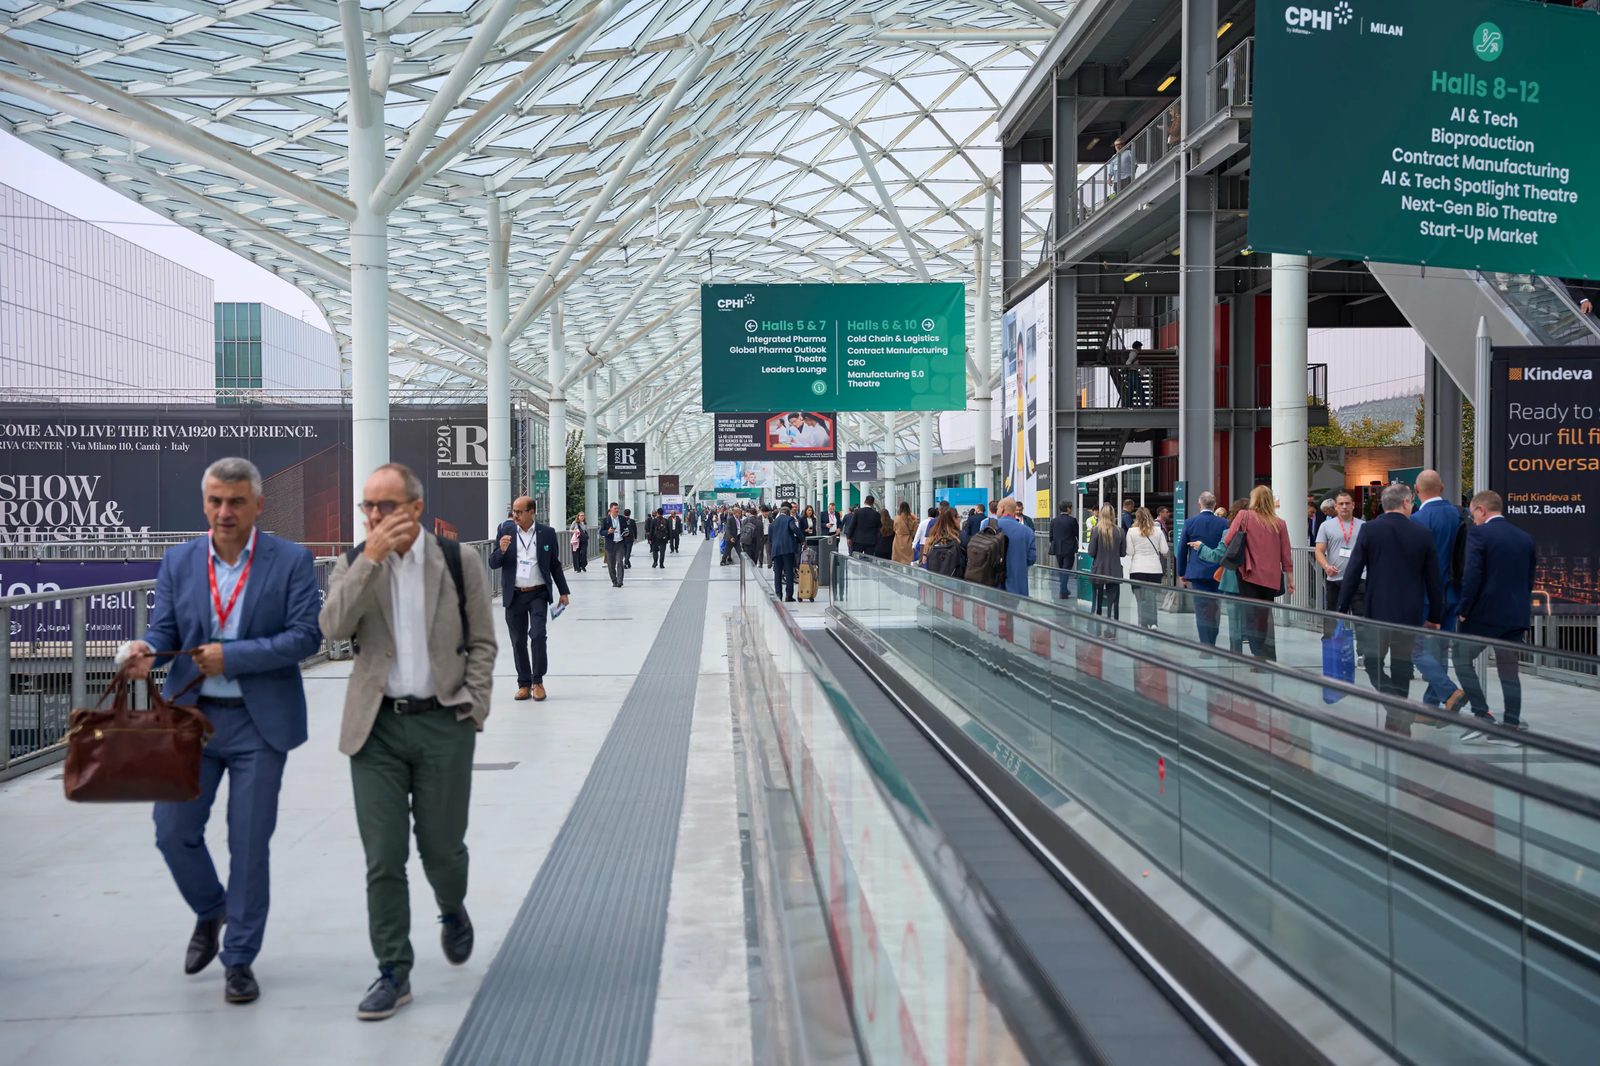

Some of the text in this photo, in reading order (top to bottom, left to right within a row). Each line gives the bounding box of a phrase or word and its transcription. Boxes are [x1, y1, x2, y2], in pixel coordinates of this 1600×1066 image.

[1285, 7, 1332, 31] CPHI
[1370, 22, 1403, 36] MILAN
[1432, 70, 1488, 97] Halls
[1450, 107, 1518, 128] AI & Tech
[1432, 128, 1534, 153] Bioproduction
[1392, 148, 1569, 184] Contract Manufacturing
[1381, 170, 1578, 203] AI & Tech Spotlight Theatre
[1401, 196, 1557, 224] Next-Gen Bio Theatre
[1420, 221, 1538, 245] Start-Up Market
[717, 300, 744, 308] CPHI
[762, 320, 826, 330] Halls 5 & 7
[848, 320, 917, 330] Halls 6 & 10
[747, 336, 791, 344] Integrated
[903, 334, 939, 343] Logistics
[886, 346, 948, 356] Manufacturing
[796, 366, 827, 374] Lounge
[848, 370, 910, 379] Manufacturing
[1524, 368, 1592, 380] Kindeva
[848, 379, 880, 388] Theatre
[1509, 403, 1569, 423] Ready
[1573, 404, 1592, 419] to
[44, 425, 77, 437] AND
[80, 425, 115, 437] LIVE
[118, 425, 148, 437] THE
[152, 424, 216, 437] RIVA1920
[220, 426, 318, 438] EXPERIENCE.
[437, 425, 488, 465] 1920 R
[1508, 433, 1552, 449] your
[1557, 428, 1584, 445] fill
[22, 441, 62, 450] CENTER
[72, 442, 85, 450] Via
[88, 442, 116, 450] Milano
[119, 442, 133, 451] 110,
[136, 442, 160, 450] Cantù
[171, 442, 190, 452] Italy
[620, 448, 636, 464] R
[0, 474, 101, 500] SHOW
[1508, 493, 1528, 501] Find
[1530, 493, 1568, 501] Kindeva
[0, 500, 124, 526] ROOM&
[1508, 505, 1526, 514] Hall
[1530, 506, 1542, 515] 12,
[1544, 505, 1572, 514] Booth
